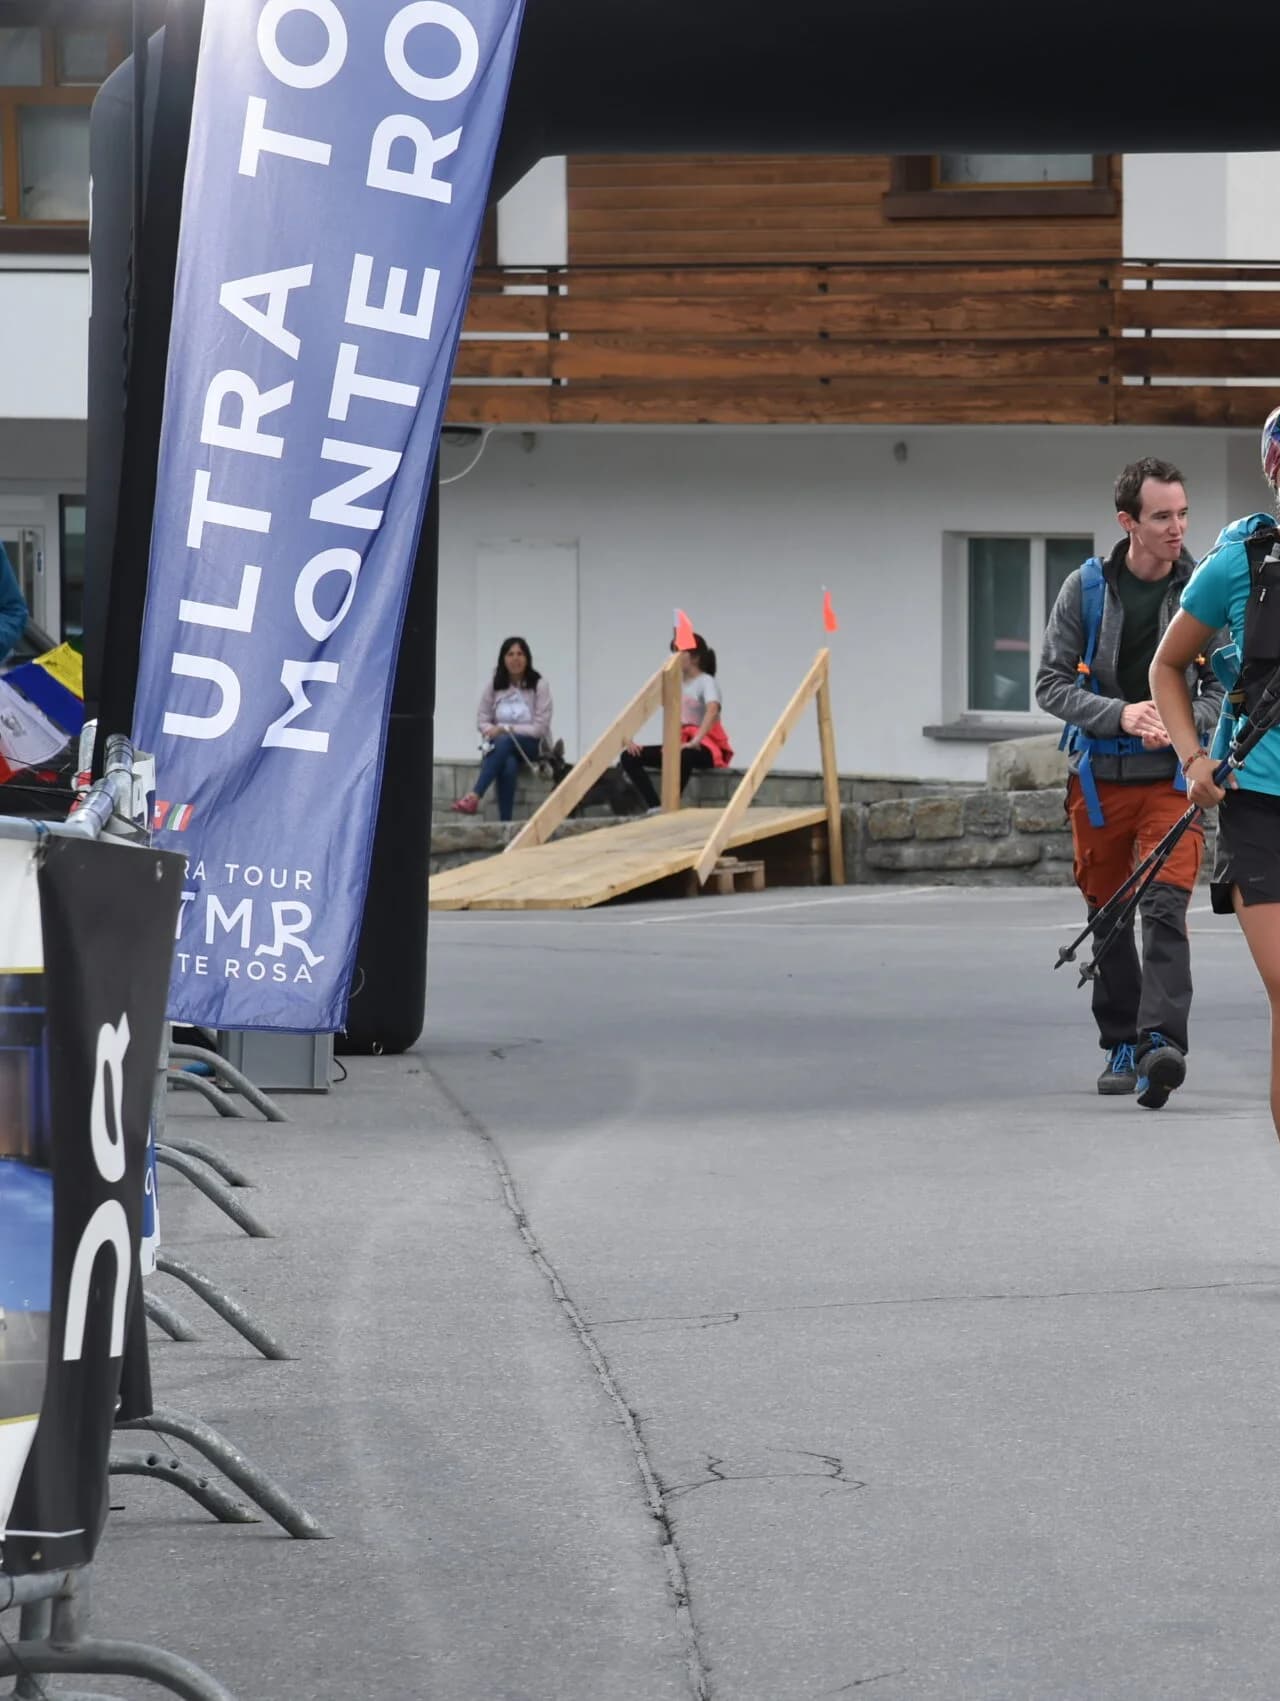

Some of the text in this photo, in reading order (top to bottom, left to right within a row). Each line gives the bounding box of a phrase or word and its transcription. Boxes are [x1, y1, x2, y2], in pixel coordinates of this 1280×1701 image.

[162, 264, 313, 740] ULTRA
[261, 0, 479, 753] MONTE RO
[225, 863, 312, 890] TOUR
[225, 958, 313, 984] ROSA
